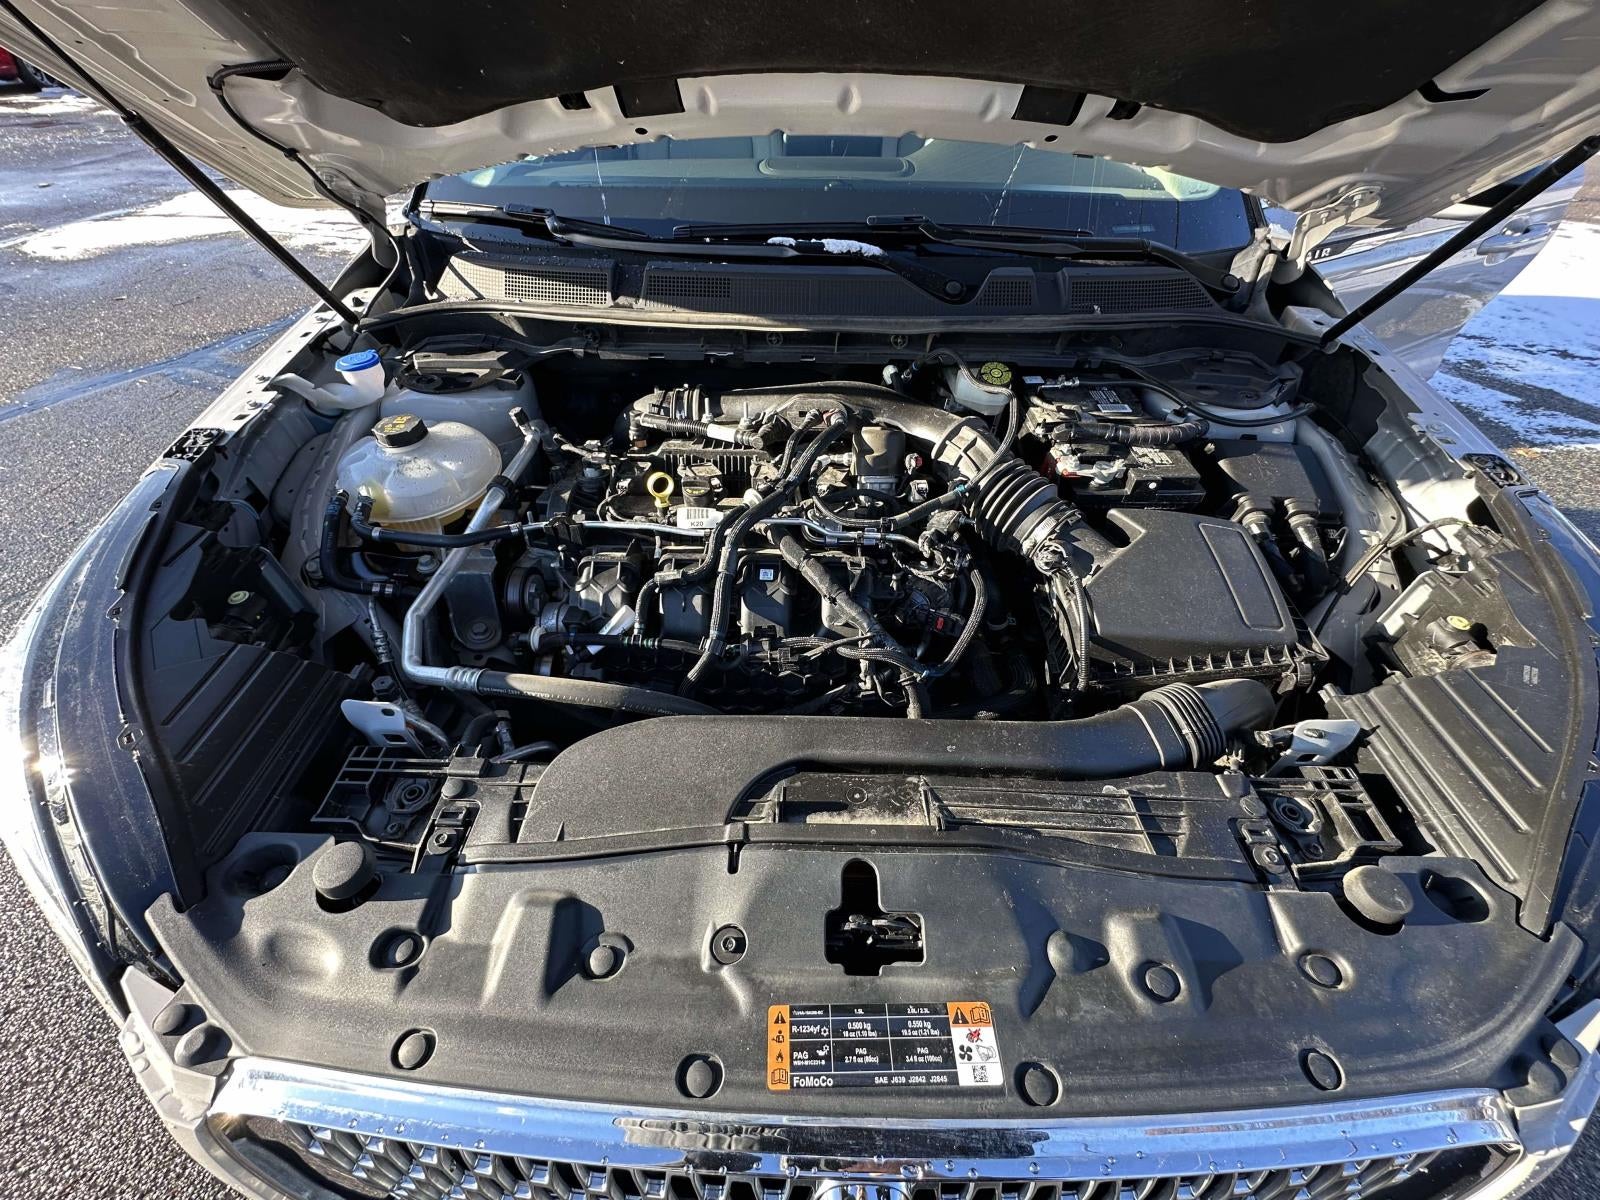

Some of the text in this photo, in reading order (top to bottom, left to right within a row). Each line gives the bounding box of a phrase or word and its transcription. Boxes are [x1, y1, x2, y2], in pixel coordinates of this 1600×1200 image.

[864, 1022, 871, 1031] kg
[924, 1020, 931, 1029] kg
[792, 1025, 820, 1034] R-1234yf
[793, 1051, 808, 1059] PAG
[793, 1076, 833, 1087] FoMoCo
